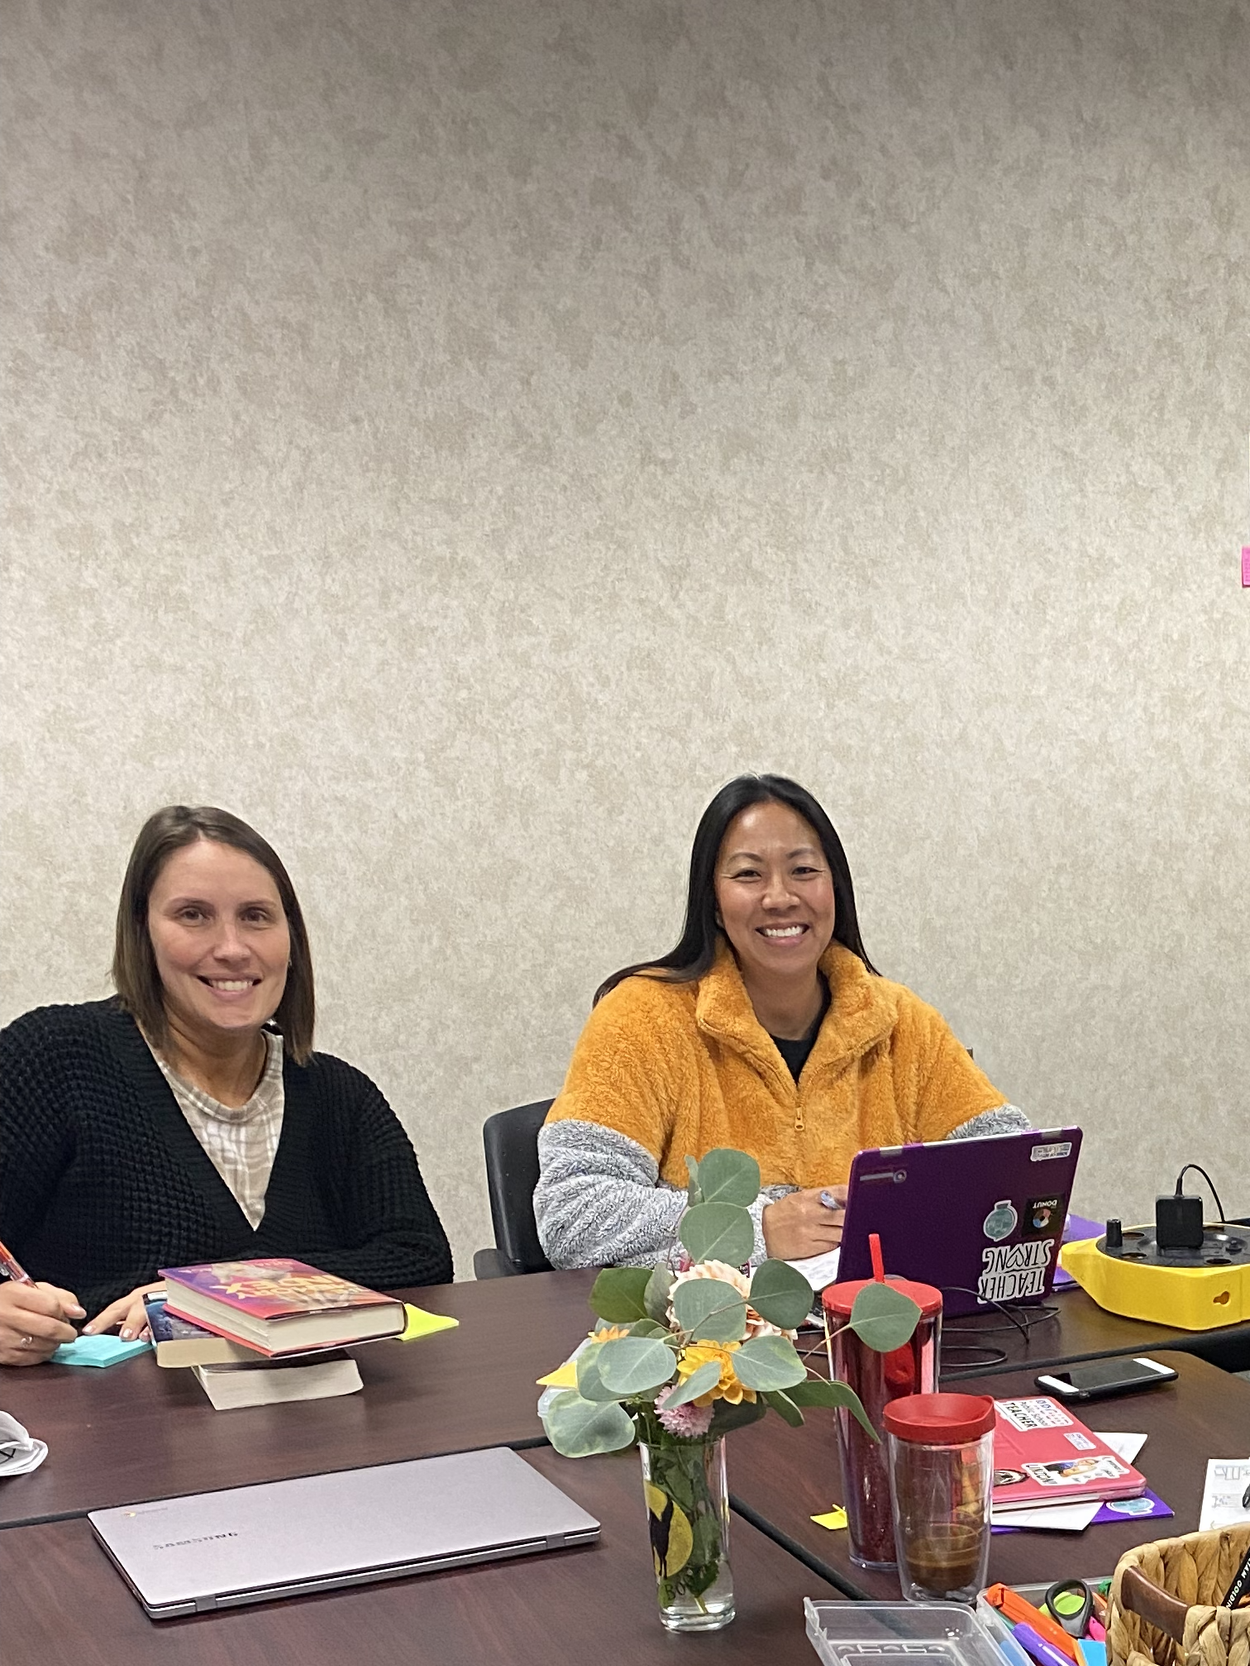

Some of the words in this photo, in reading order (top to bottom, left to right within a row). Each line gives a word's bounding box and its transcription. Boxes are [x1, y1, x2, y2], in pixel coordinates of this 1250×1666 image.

[1032, 1199, 1058, 1209] DONUT
[980, 1269, 1044, 1300] TEACHER
[1225, 1580, 1243, 1609] GOLDIN
